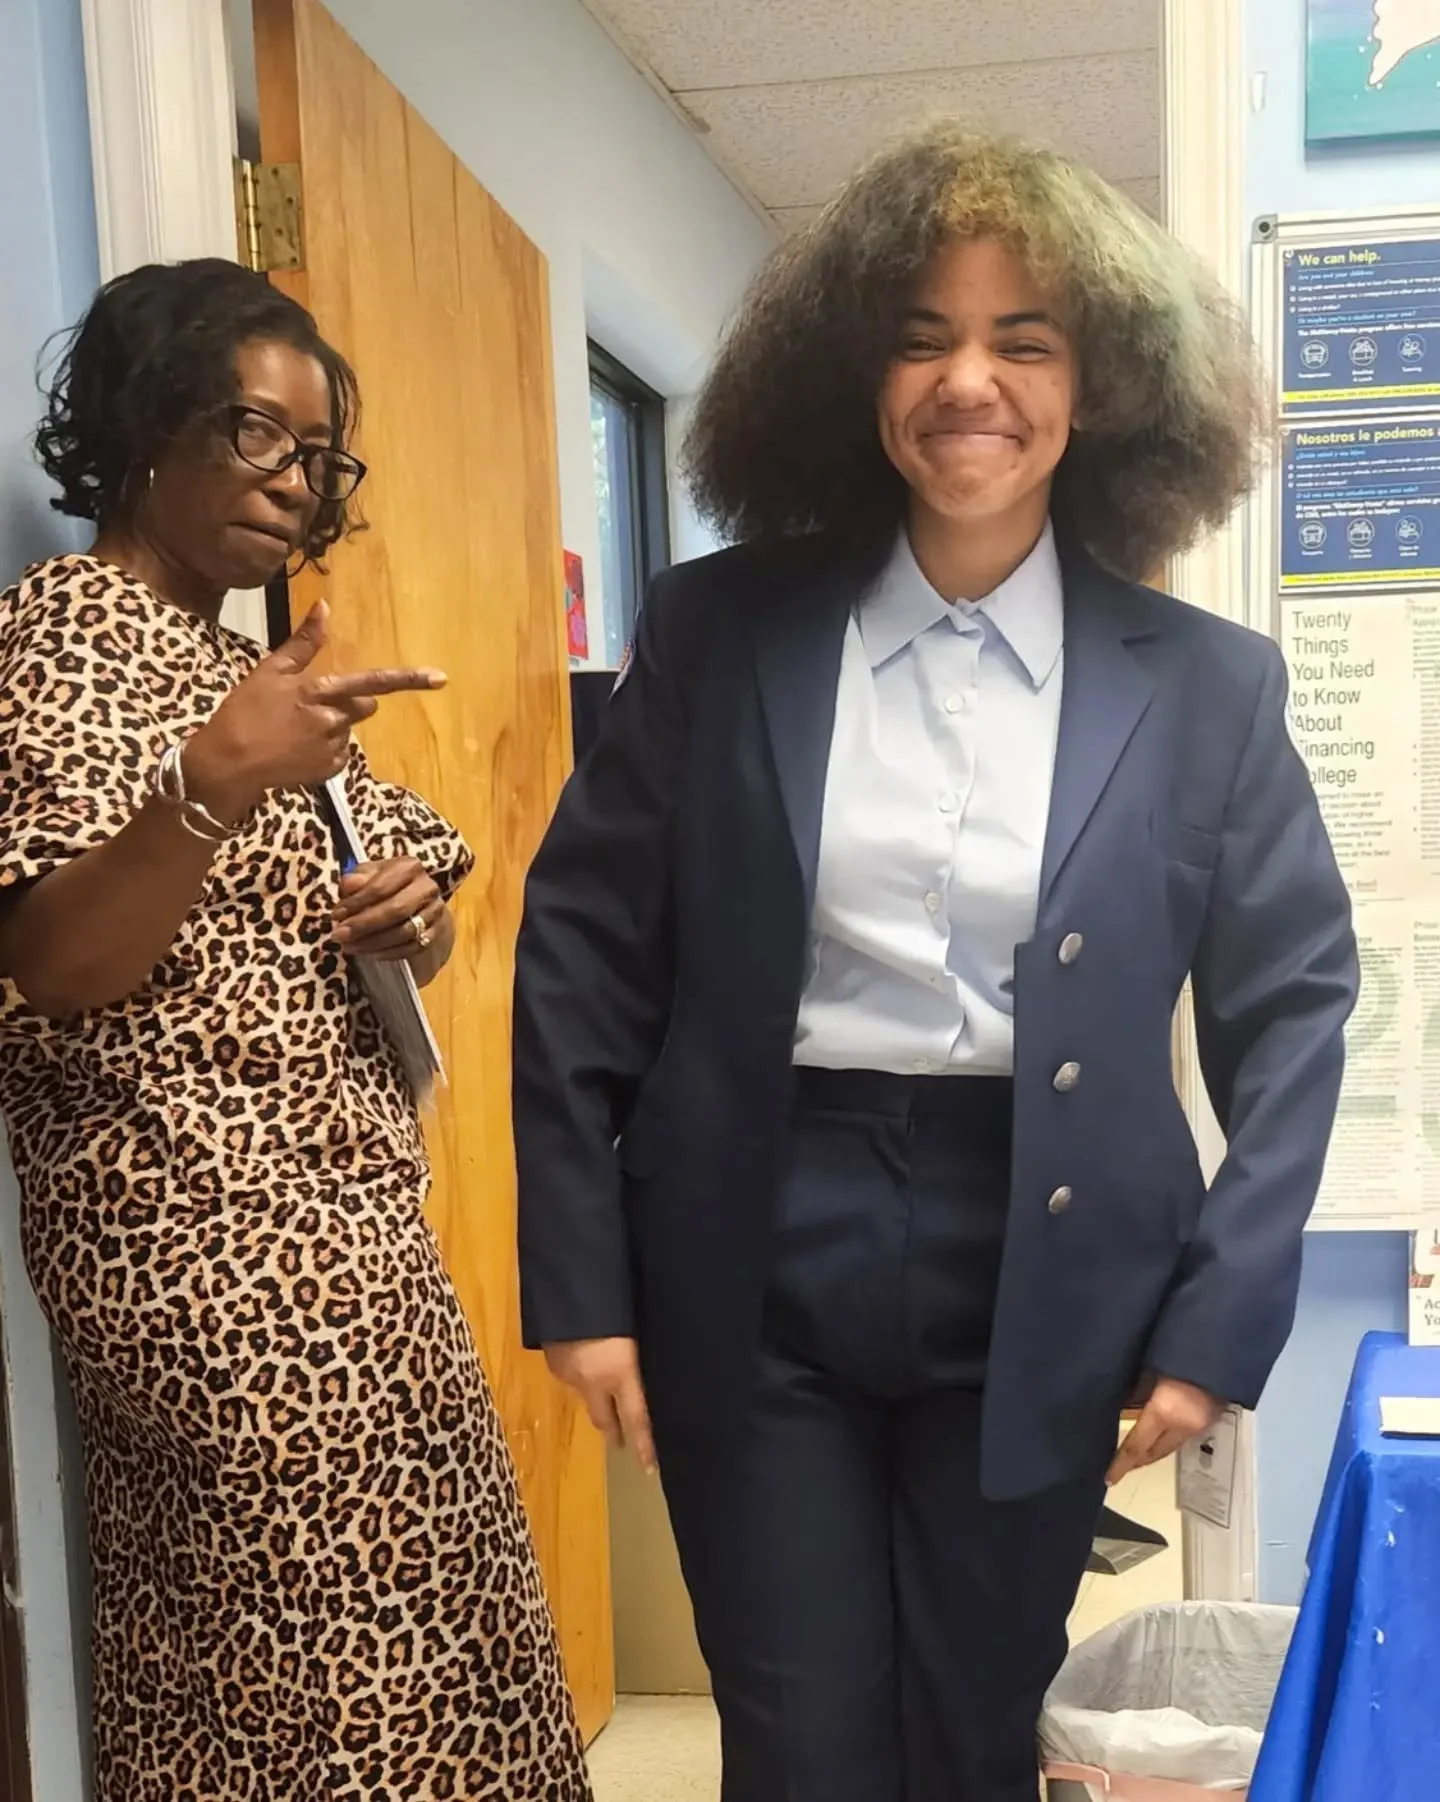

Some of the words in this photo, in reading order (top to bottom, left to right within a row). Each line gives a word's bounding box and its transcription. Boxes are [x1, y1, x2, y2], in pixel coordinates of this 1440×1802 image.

[1298, 254, 1319, 265] We
[1324, 254, 1345, 265] can
[1349, 249, 1380, 264] help.
[1296, 433, 1355, 445] Nosotros
[1359, 430, 1370, 440] le
[1374, 426, 1434, 444] podemos
[1292, 611, 1352, 631] Twenty
[1292, 637, 1349, 658] Things
[1293, 663, 1324, 681] You
[1330, 659, 1375, 679] Need
[1293, 690, 1308, 707] to
[1314, 688, 1361, 705] Know
[1295, 715, 1342, 732] About
